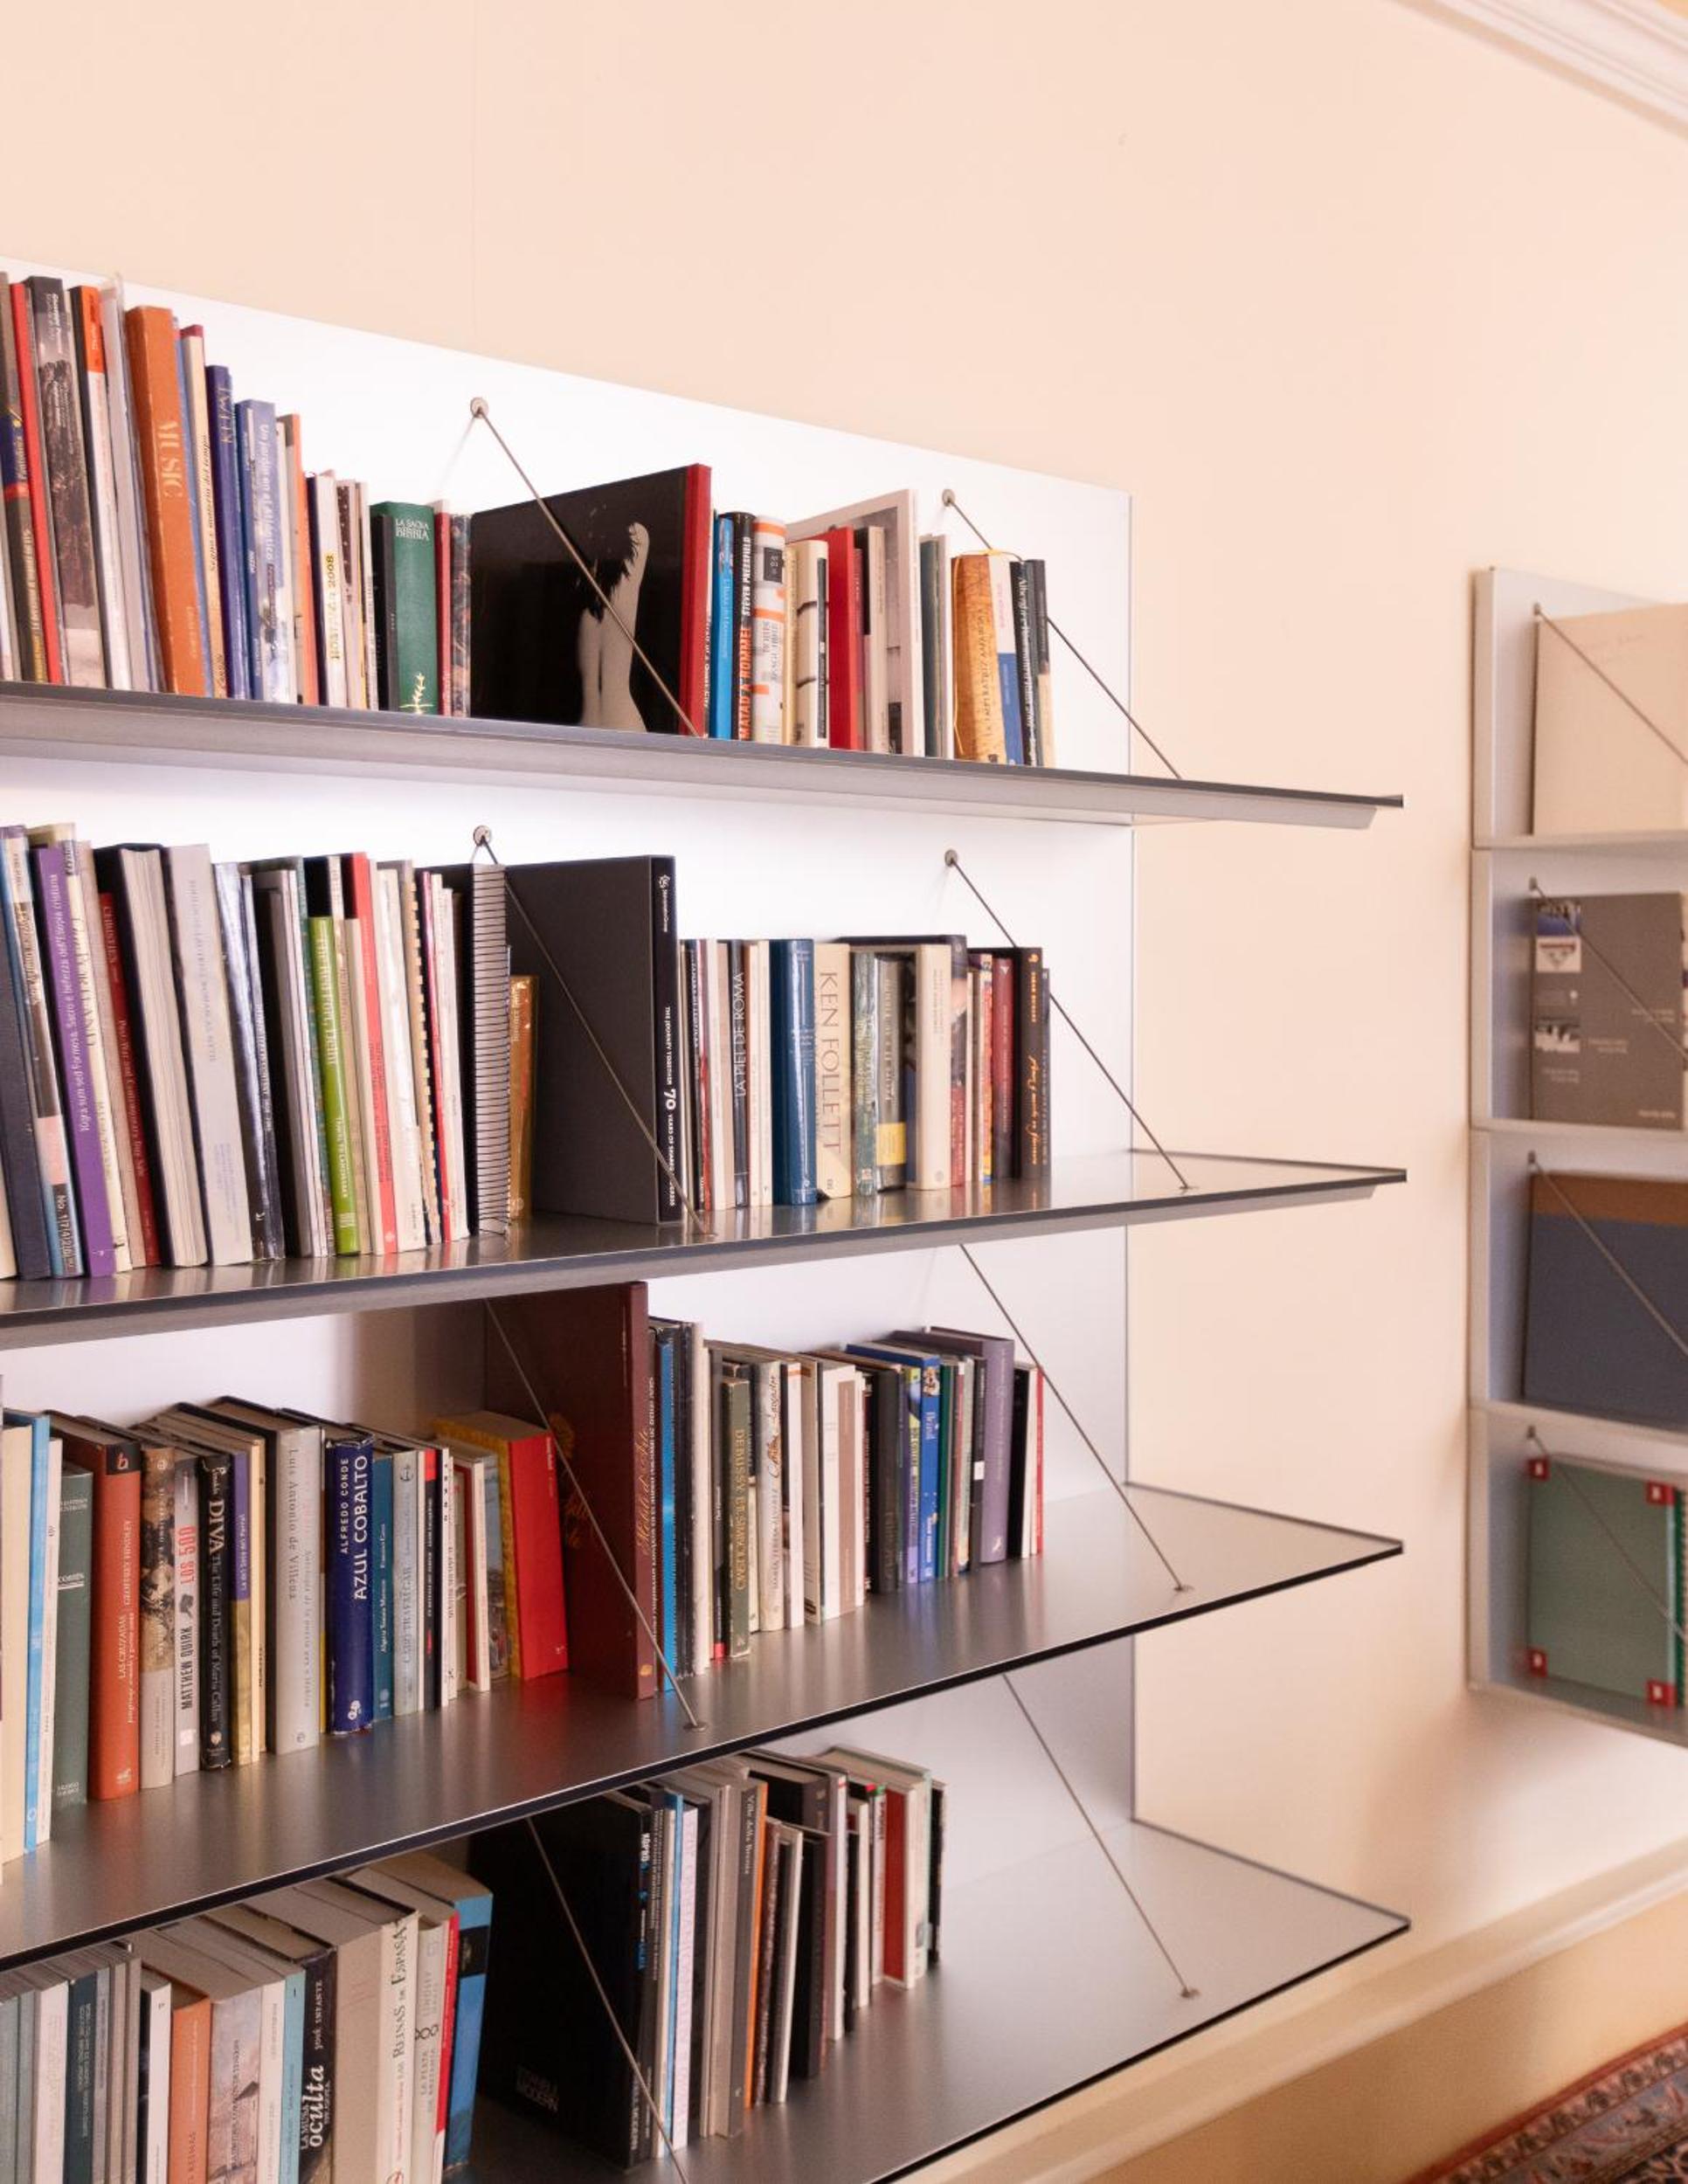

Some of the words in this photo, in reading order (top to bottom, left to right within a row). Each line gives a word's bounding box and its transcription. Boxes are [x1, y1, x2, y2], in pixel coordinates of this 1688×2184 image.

[259, 424, 270, 439] Un
[156, 418, 183, 501] MUSIC
[261, 478, 270, 491] en
[326, 555, 336, 588] 2008
[741, 536, 751, 583] PRESSFIELD
[741, 584, 751, 616] STEVEN
[739, 626, 751, 678] ROMMEL
[739, 696, 751, 739] MATAD
[733, 972, 744, 1019] ROMA
[820, 972, 839, 1027] KEN
[734, 1026, 745, 1045] DE
[734, 1052, 746, 1076] PIEL
[664, 1089, 676, 1109] 70
[734, 1080, 746, 1097] LA
[821, 1039, 841, 1154] FOLLETT
[668, 1136, 674, 1144] OF
[287, 1449, 299, 1475] Luis
[340, 1458, 349, 1496] CONDE
[287, 1481, 299, 1531] Antonio
[354, 1455, 368, 1543] COBALTO
[123, 1521, 132, 1560] HINDLEY
[177, 1526, 196, 1557] 500
[209, 1500, 225, 1555] DIVA
[287, 1536, 299, 1551] de
[340, 1502, 349, 1554] ALFREDO
[180, 1561, 195, 1585] LOS
[211, 1555, 222, 1571] The
[287, 1555, 299, 1600] Villena
[354, 1548, 367, 1600] AZUL
[122, 1562, 132, 1606] GEOFFREY
[211, 1575, 222, 1594] Life
[211, 1599, 222, 1614] and
[180, 1626, 193, 1657] QUIRK
[211, 1618, 222, 1646] Death
[211, 1649, 222, 1660] of
[180, 1661, 193, 1711] MATTHEW
[211, 1662, 222, 1689] Maria
[211, 1690, 222, 1722] Callas
[391, 1924, 408, 1986] ESPAÑA
[315, 1980, 323, 2024] INFANTE
[392, 2005, 406, 2059] REINAS
[302, 2064, 324, 2147] oculta
